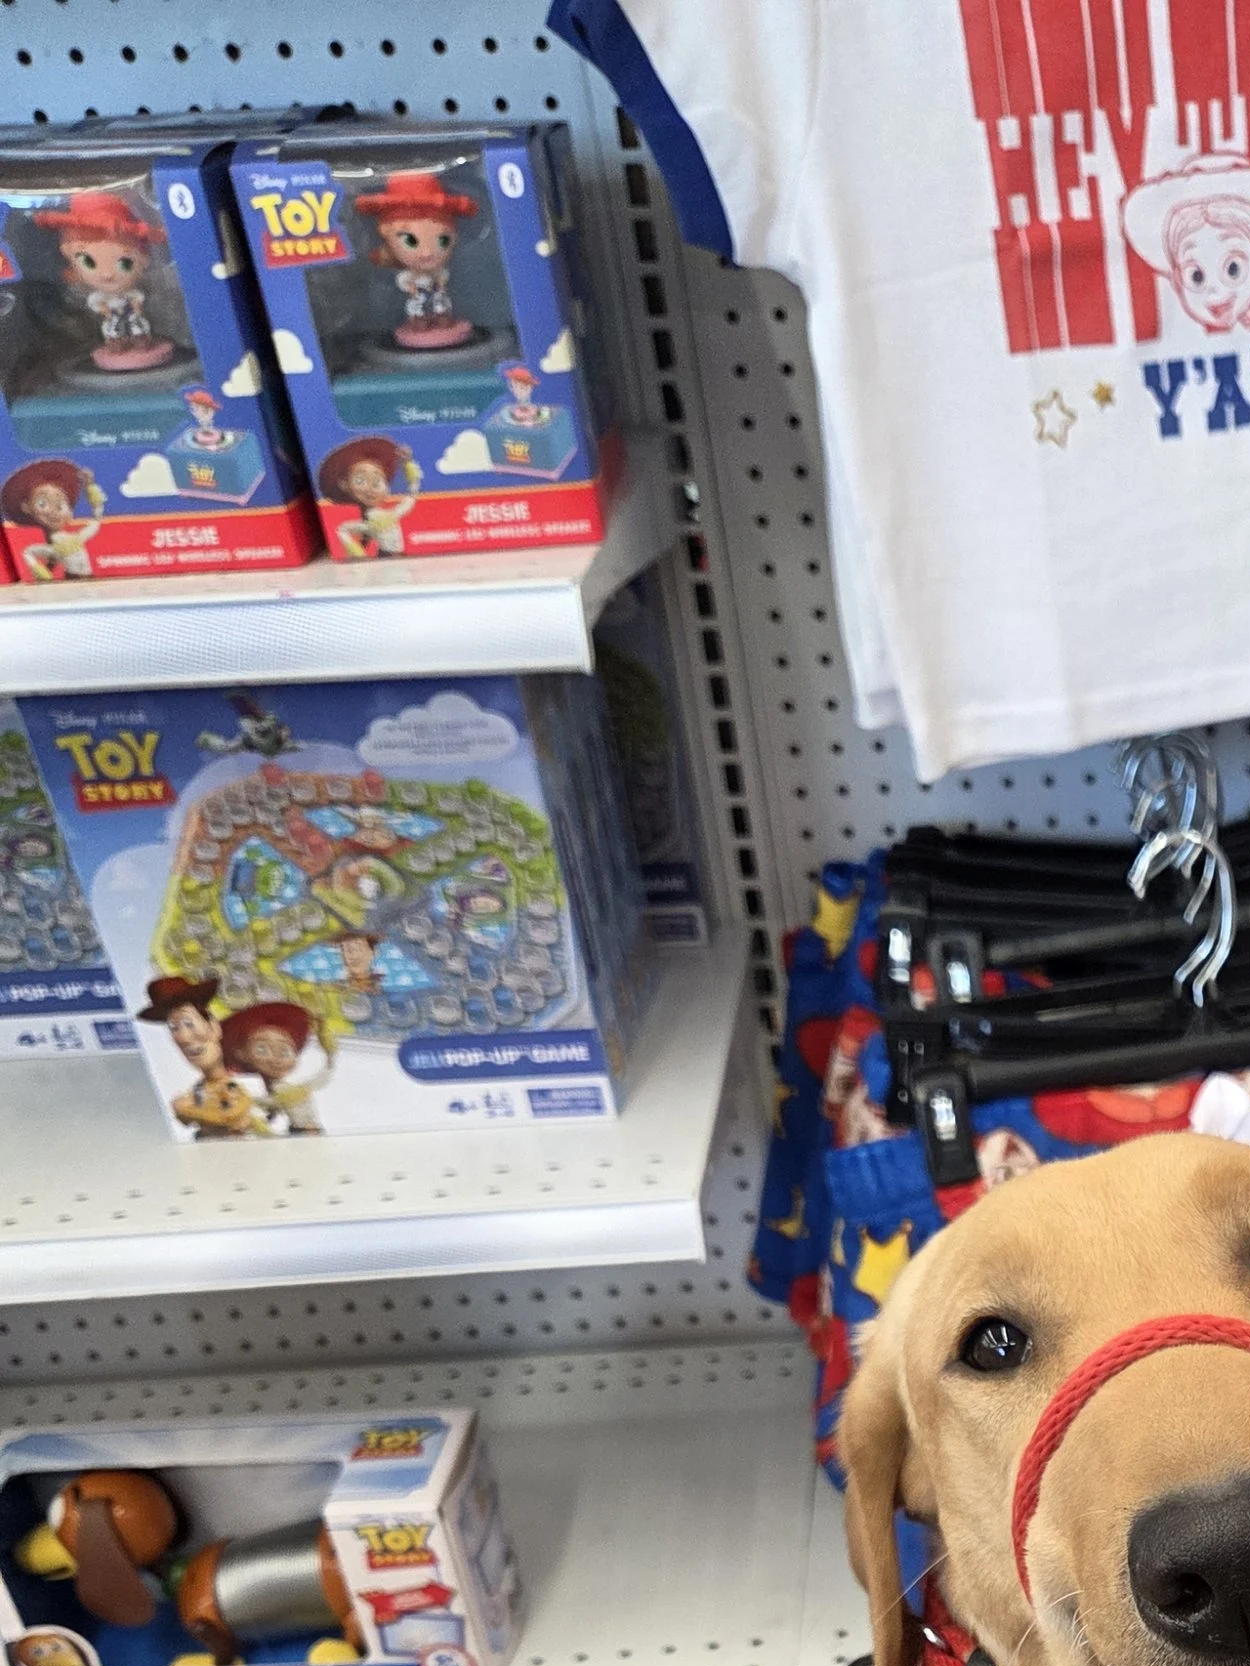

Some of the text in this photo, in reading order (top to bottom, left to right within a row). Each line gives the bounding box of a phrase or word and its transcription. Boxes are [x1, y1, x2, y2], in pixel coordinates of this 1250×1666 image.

[250, 190, 337, 237] TOY
[269, 236, 338, 257] STORY
[463, 501, 531, 523] JESSIE
[152, 525, 220, 547] JESSIE
[55, 730, 160, 779] TOY
[82, 780, 163, 802] STORY
[531, 1041, 590, 1063] GAME
[361, 1427, 432, 1449] TOY
[355, 1521, 434, 1553] TOY
